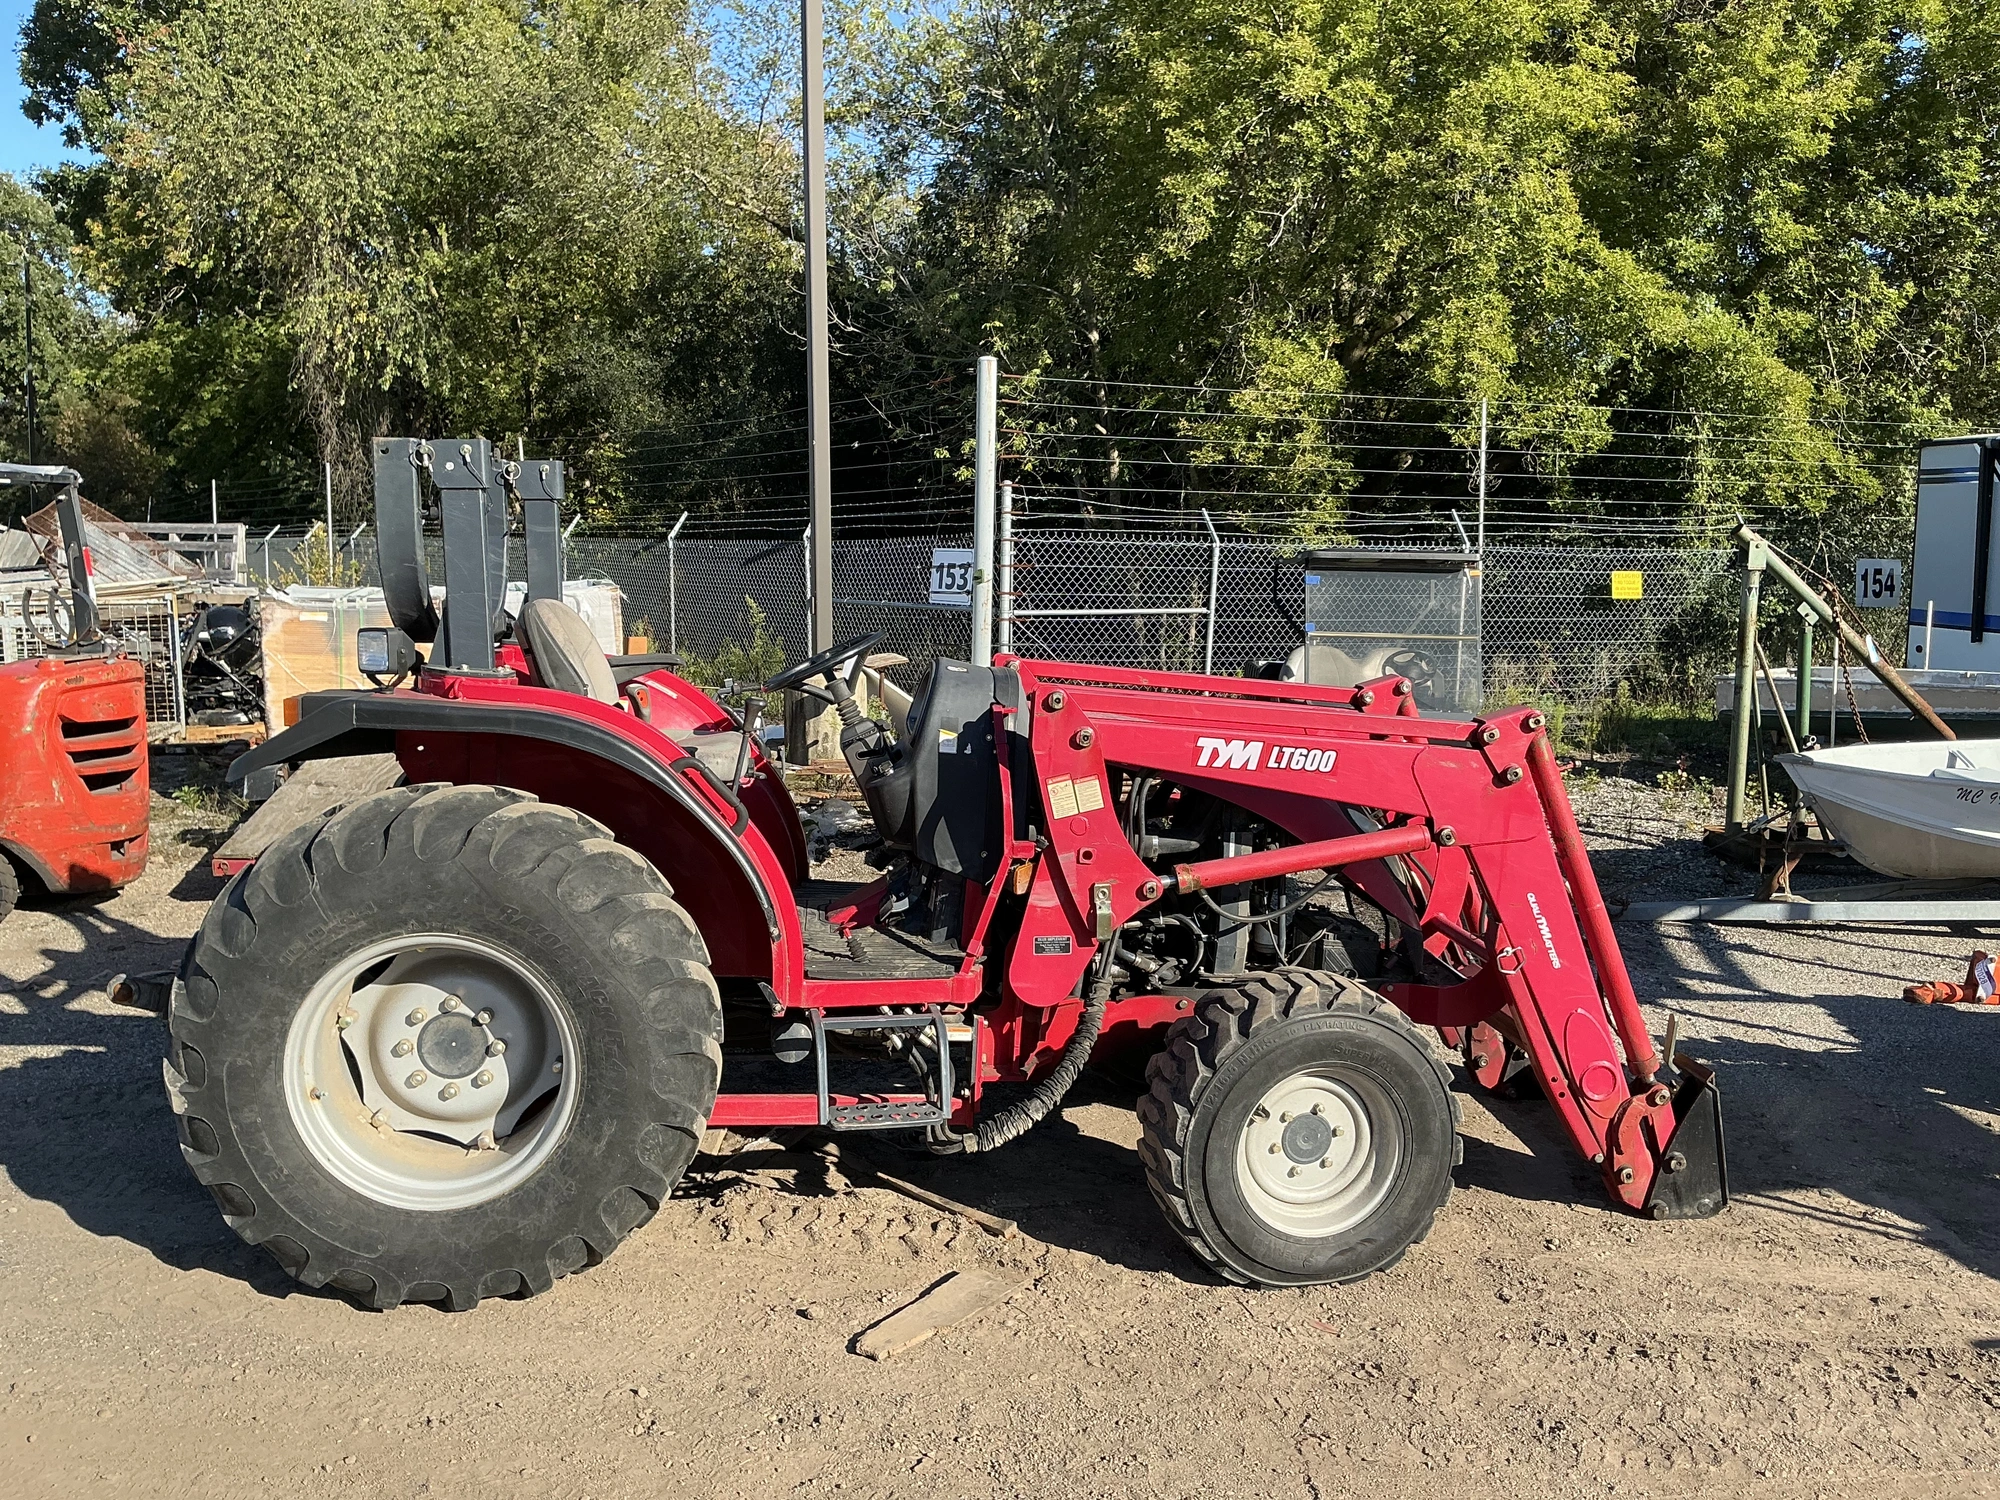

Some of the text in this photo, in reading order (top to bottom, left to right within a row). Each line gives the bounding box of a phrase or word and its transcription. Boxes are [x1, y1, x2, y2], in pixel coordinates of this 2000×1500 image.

[935, 562, 970, 591] 153
[1860, 567, 1896, 599] 154
[1196, 736, 1338, 774] TYM LT600
[1956, 787, 2000, 805] MC 9
[498, 903, 575, 957] RAZOR
[1303, 1022, 1324, 1032] PLY
[1325, 1020, 1363, 1032] RATING
